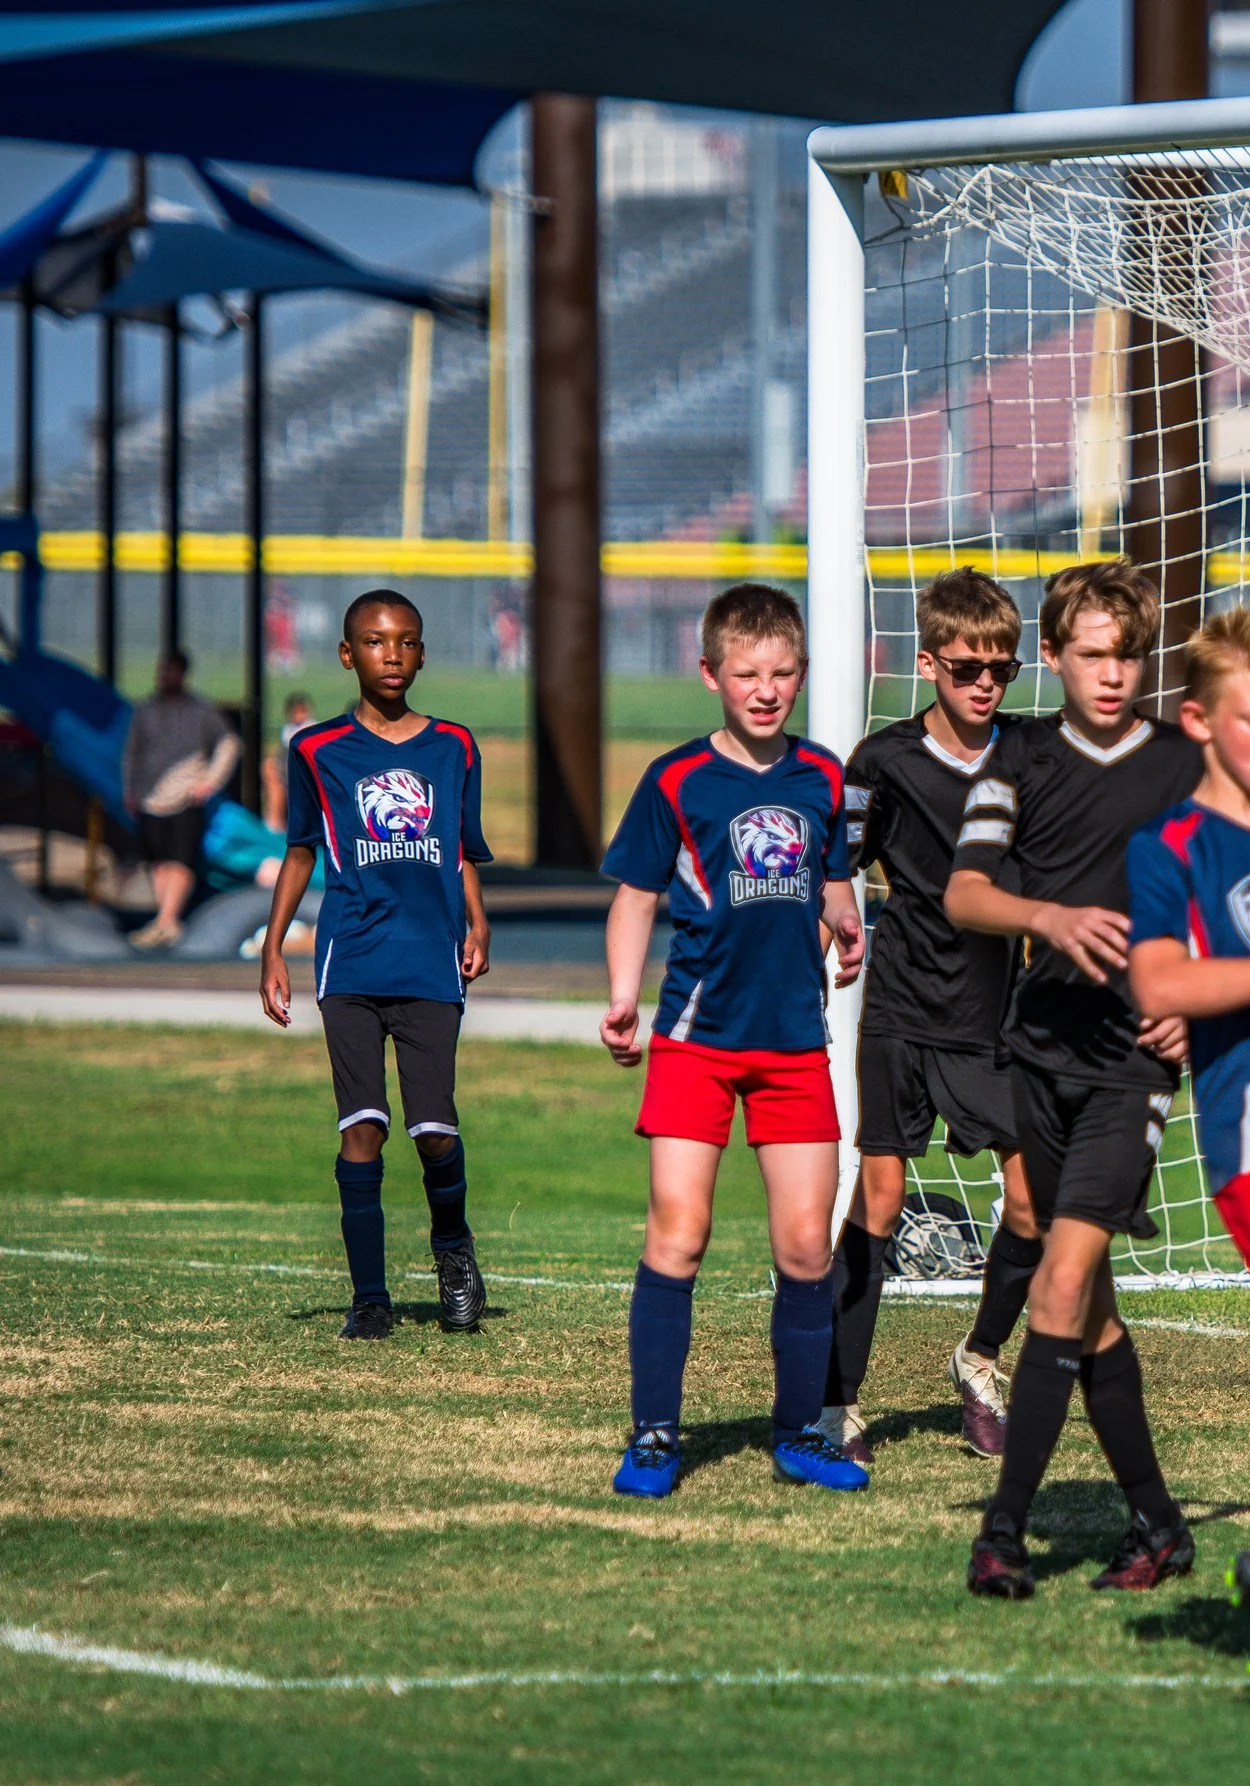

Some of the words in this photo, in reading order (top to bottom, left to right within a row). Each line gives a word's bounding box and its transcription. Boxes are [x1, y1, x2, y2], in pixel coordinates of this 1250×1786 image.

[391, 832, 406, 842] ICE
[355, 838, 440, 867] DRAGONS
[767, 869, 780, 879] ICE
[733, 873, 808, 901] DRAGONS
